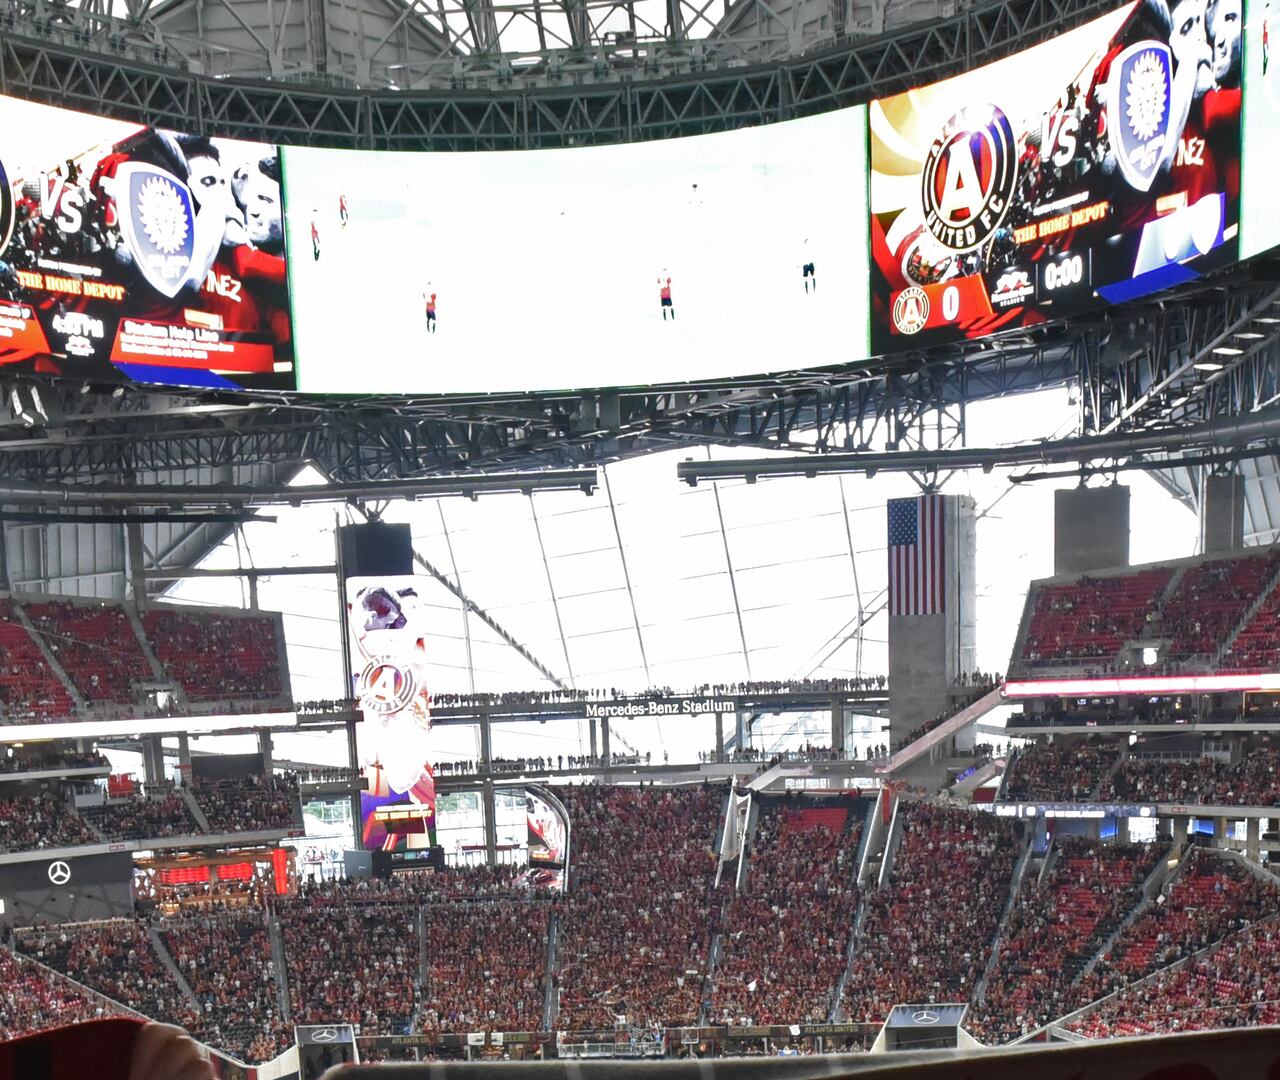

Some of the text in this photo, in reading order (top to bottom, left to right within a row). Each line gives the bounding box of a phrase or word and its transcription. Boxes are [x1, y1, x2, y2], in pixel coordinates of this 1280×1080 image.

[1040, 110, 1079, 167] VS
[939, 133, 984, 221] A
[39, 170, 84, 233] VS
[927, 209, 977, 247] UNITED
[980, 194, 1004, 228] FC
[1013, 224, 1038, 244] THE
[1038, 213, 1070, 237] HOME
[1071, 200, 1109, 227] DEPOT
[18, 271, 125, 300] THE HOME DEPOT
[1045, 255, 1083, 290] 0:00
[942, 285, 960, 321] 0
[585, 699, 735, 717] Mercedes-Benz Stadium
[392, 1036, 419, 1045] ATLANTA
[805, 1025, 859, 1034] ATLANTA UNITED
